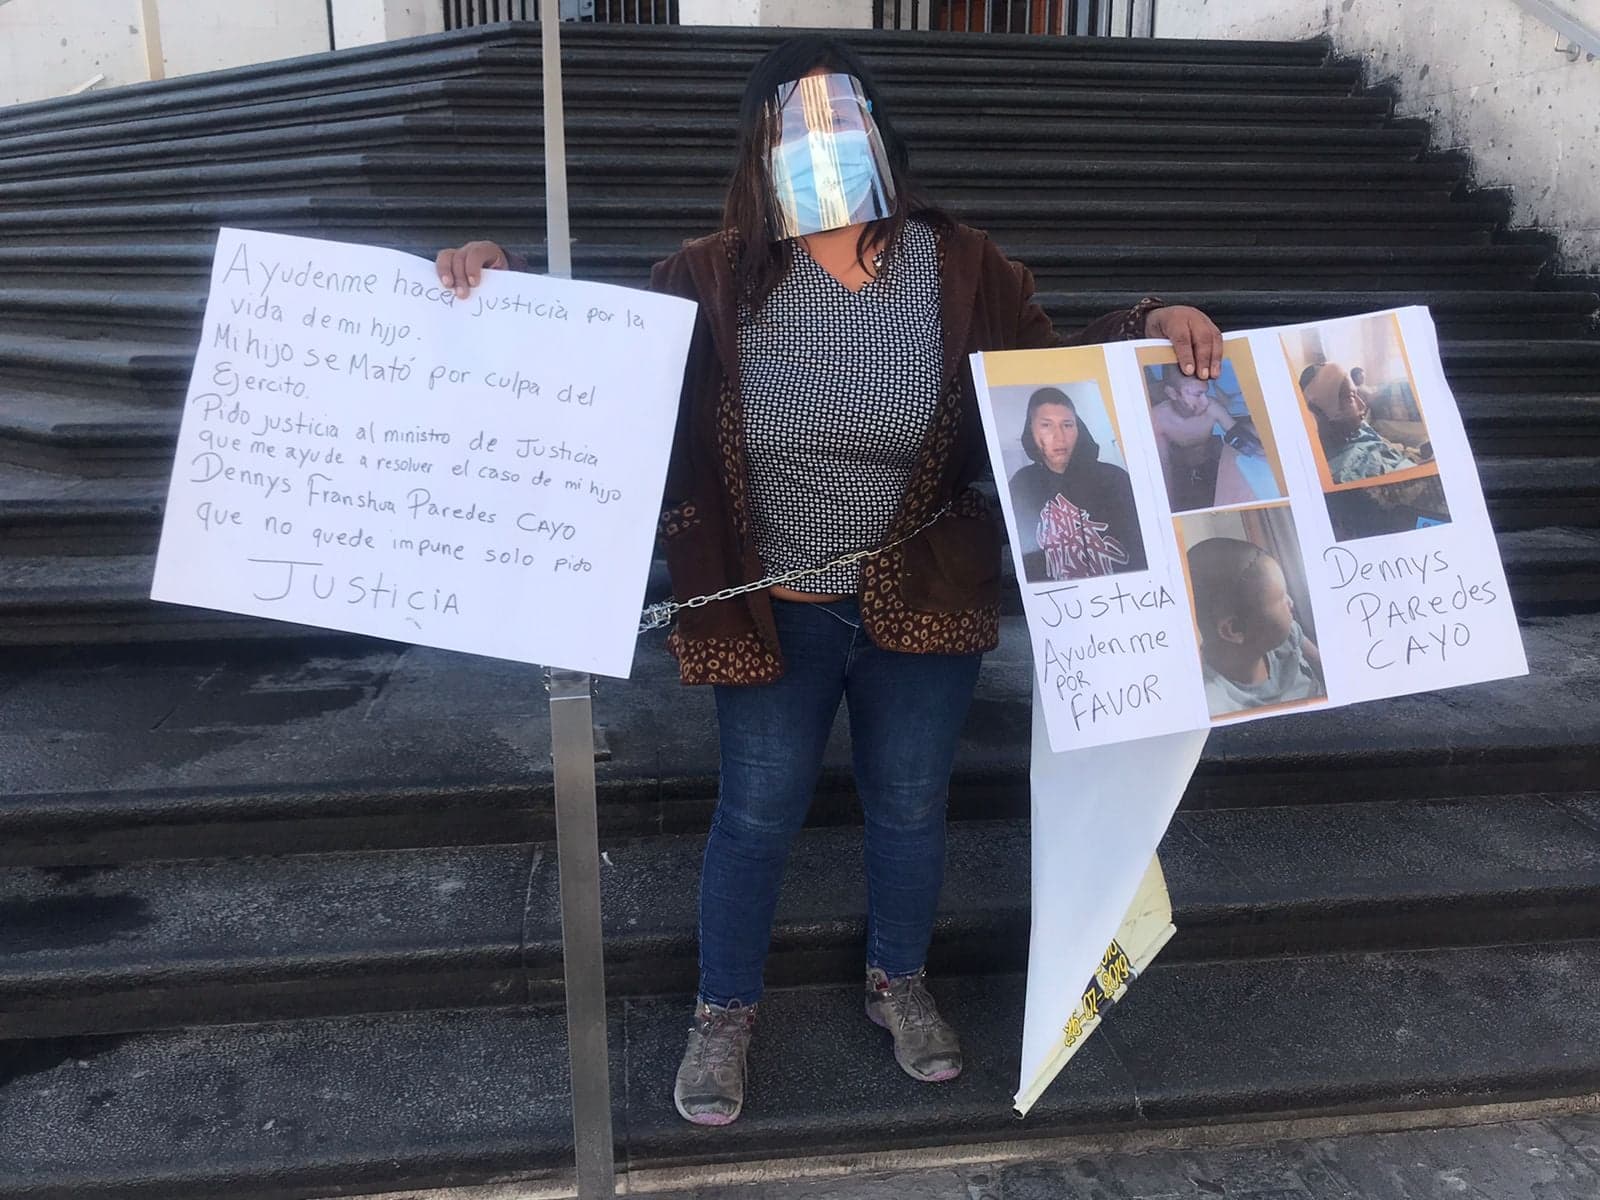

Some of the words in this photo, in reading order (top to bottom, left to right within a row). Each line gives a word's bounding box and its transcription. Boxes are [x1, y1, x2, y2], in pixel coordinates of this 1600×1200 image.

[223, 243, 377, 297] Ayudenme
[472, 294, 568, 320] justicia
[587, 307, 615, 324] por
[627, 309, 645, 329] la
[231, 296, 282, 322] vida
[429, 366, 471, 391] por
[485, 371, 540, 400] culpa
[557, 384, 597, 407] del
[192, 393, 250, 426] Pido
[356, 421, 375, 444] al
[384, 425, 451, 445] ministro
[469, 431, 498, 453] de
[516, 438, 599, 466] Justicia
[190, 452, 292, 499] Dennys
[406, 487, 497, 524] Paredes
[198, 430, 241, 451] que
[250, 440, 276, 458] me
[285, 448, 344, 469] ayude
[359, 455, 368, 469] a
[377, 456, 434, 474] resolver
[451, 459, 469, 478] el
[478, 465, 521, 483] caso
[531, 470, 552, 487] de
[565, 478, 582, 491] mi
[589, 480, 622, 504] hijo
[196, 502, 243, 532] que
[265, 516, 293, 535] no
[313, 528, 376, 548] quede
[392, 533, 465, 561] impune
[485, 548, 534, 567] solo
[554, 555, 593, 573] pido
[1323, 546, 1449, 589] Dennys
[1366, 623, 1470, 669] CAYO
[1071, 674, 1162, 731] FAVOR
